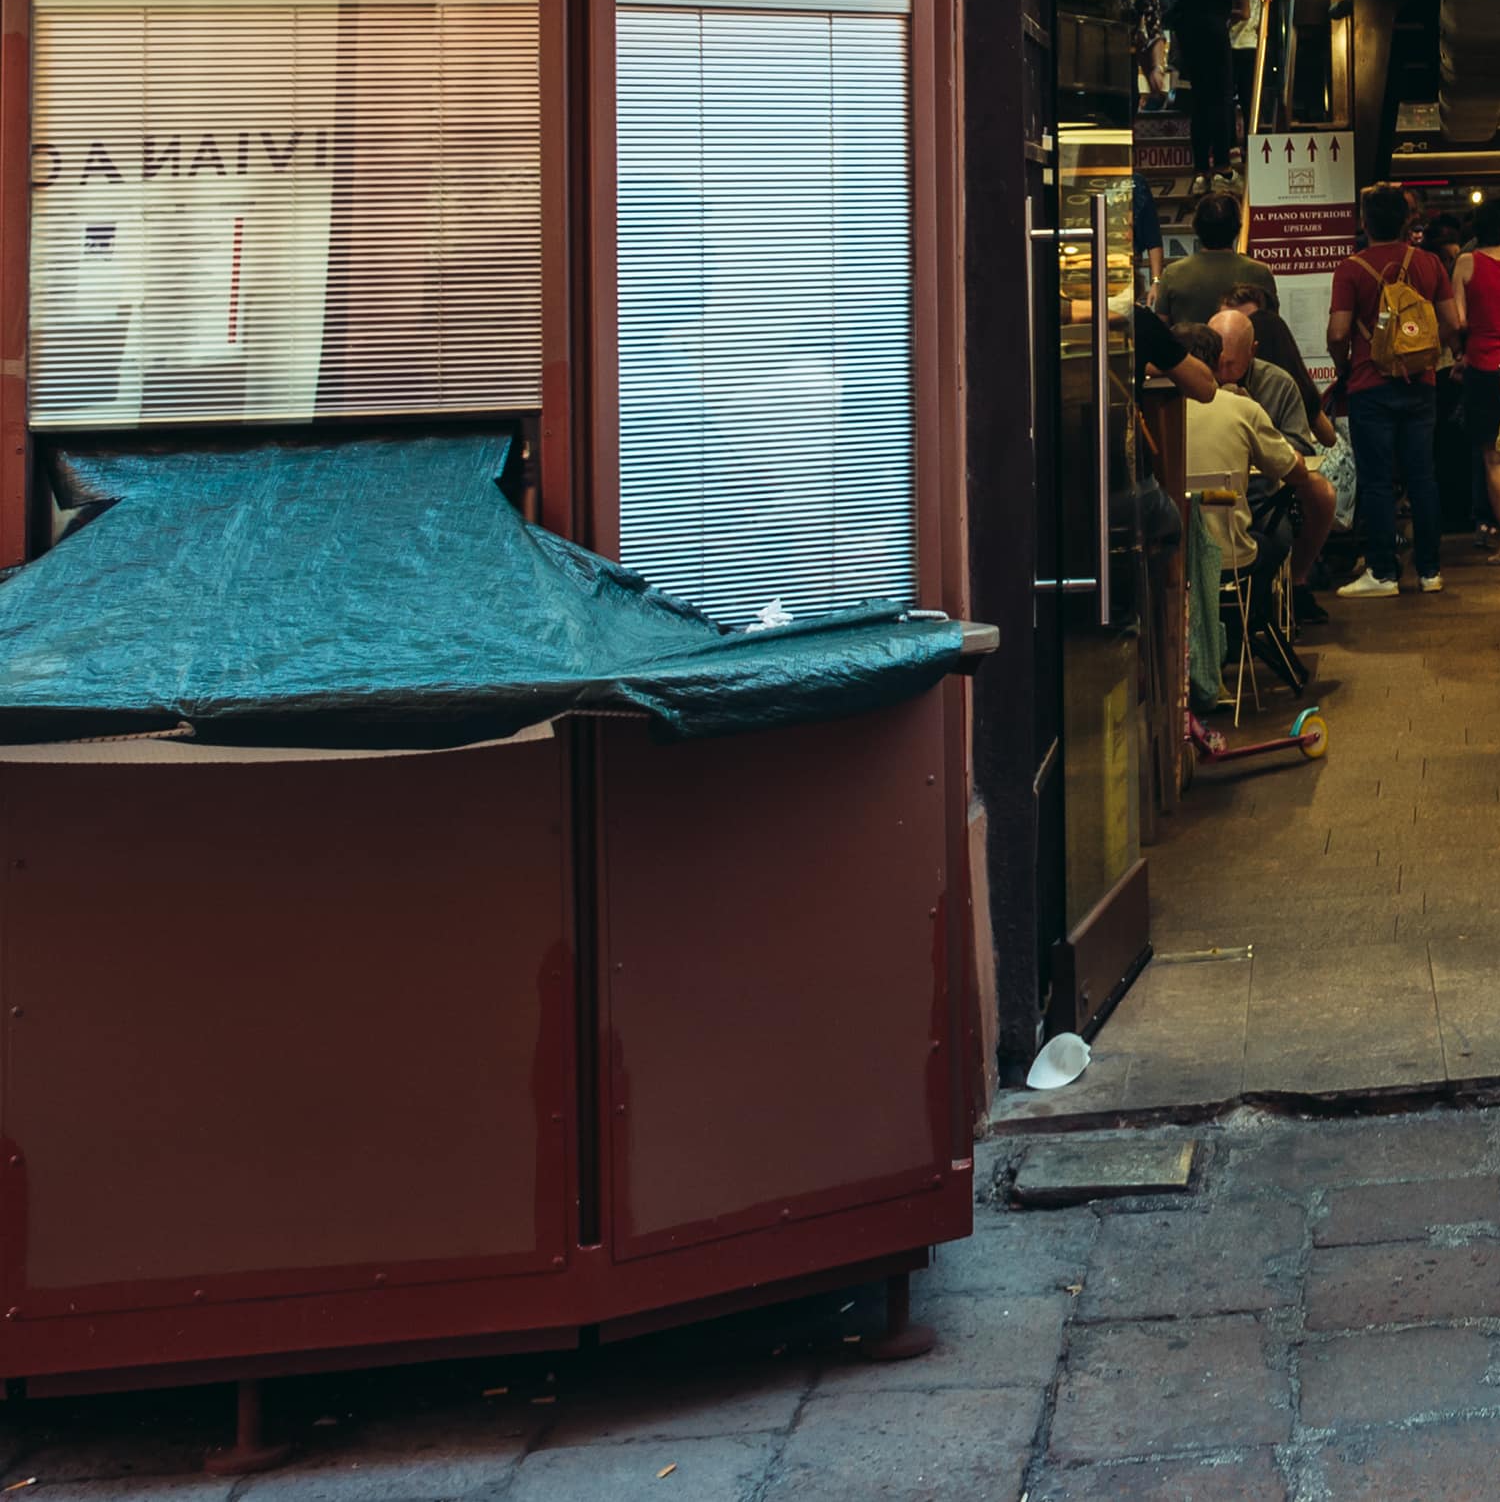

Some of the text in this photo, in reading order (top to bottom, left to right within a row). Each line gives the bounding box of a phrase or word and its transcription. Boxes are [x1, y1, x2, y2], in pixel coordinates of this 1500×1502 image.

[1253, 210, 1352, 221] AL PIANO SUPERIORE
[1284, 224, 1322, 233] UPSTAIRS
[1253, 245, 1354, 258] POSTI A SEDERE
